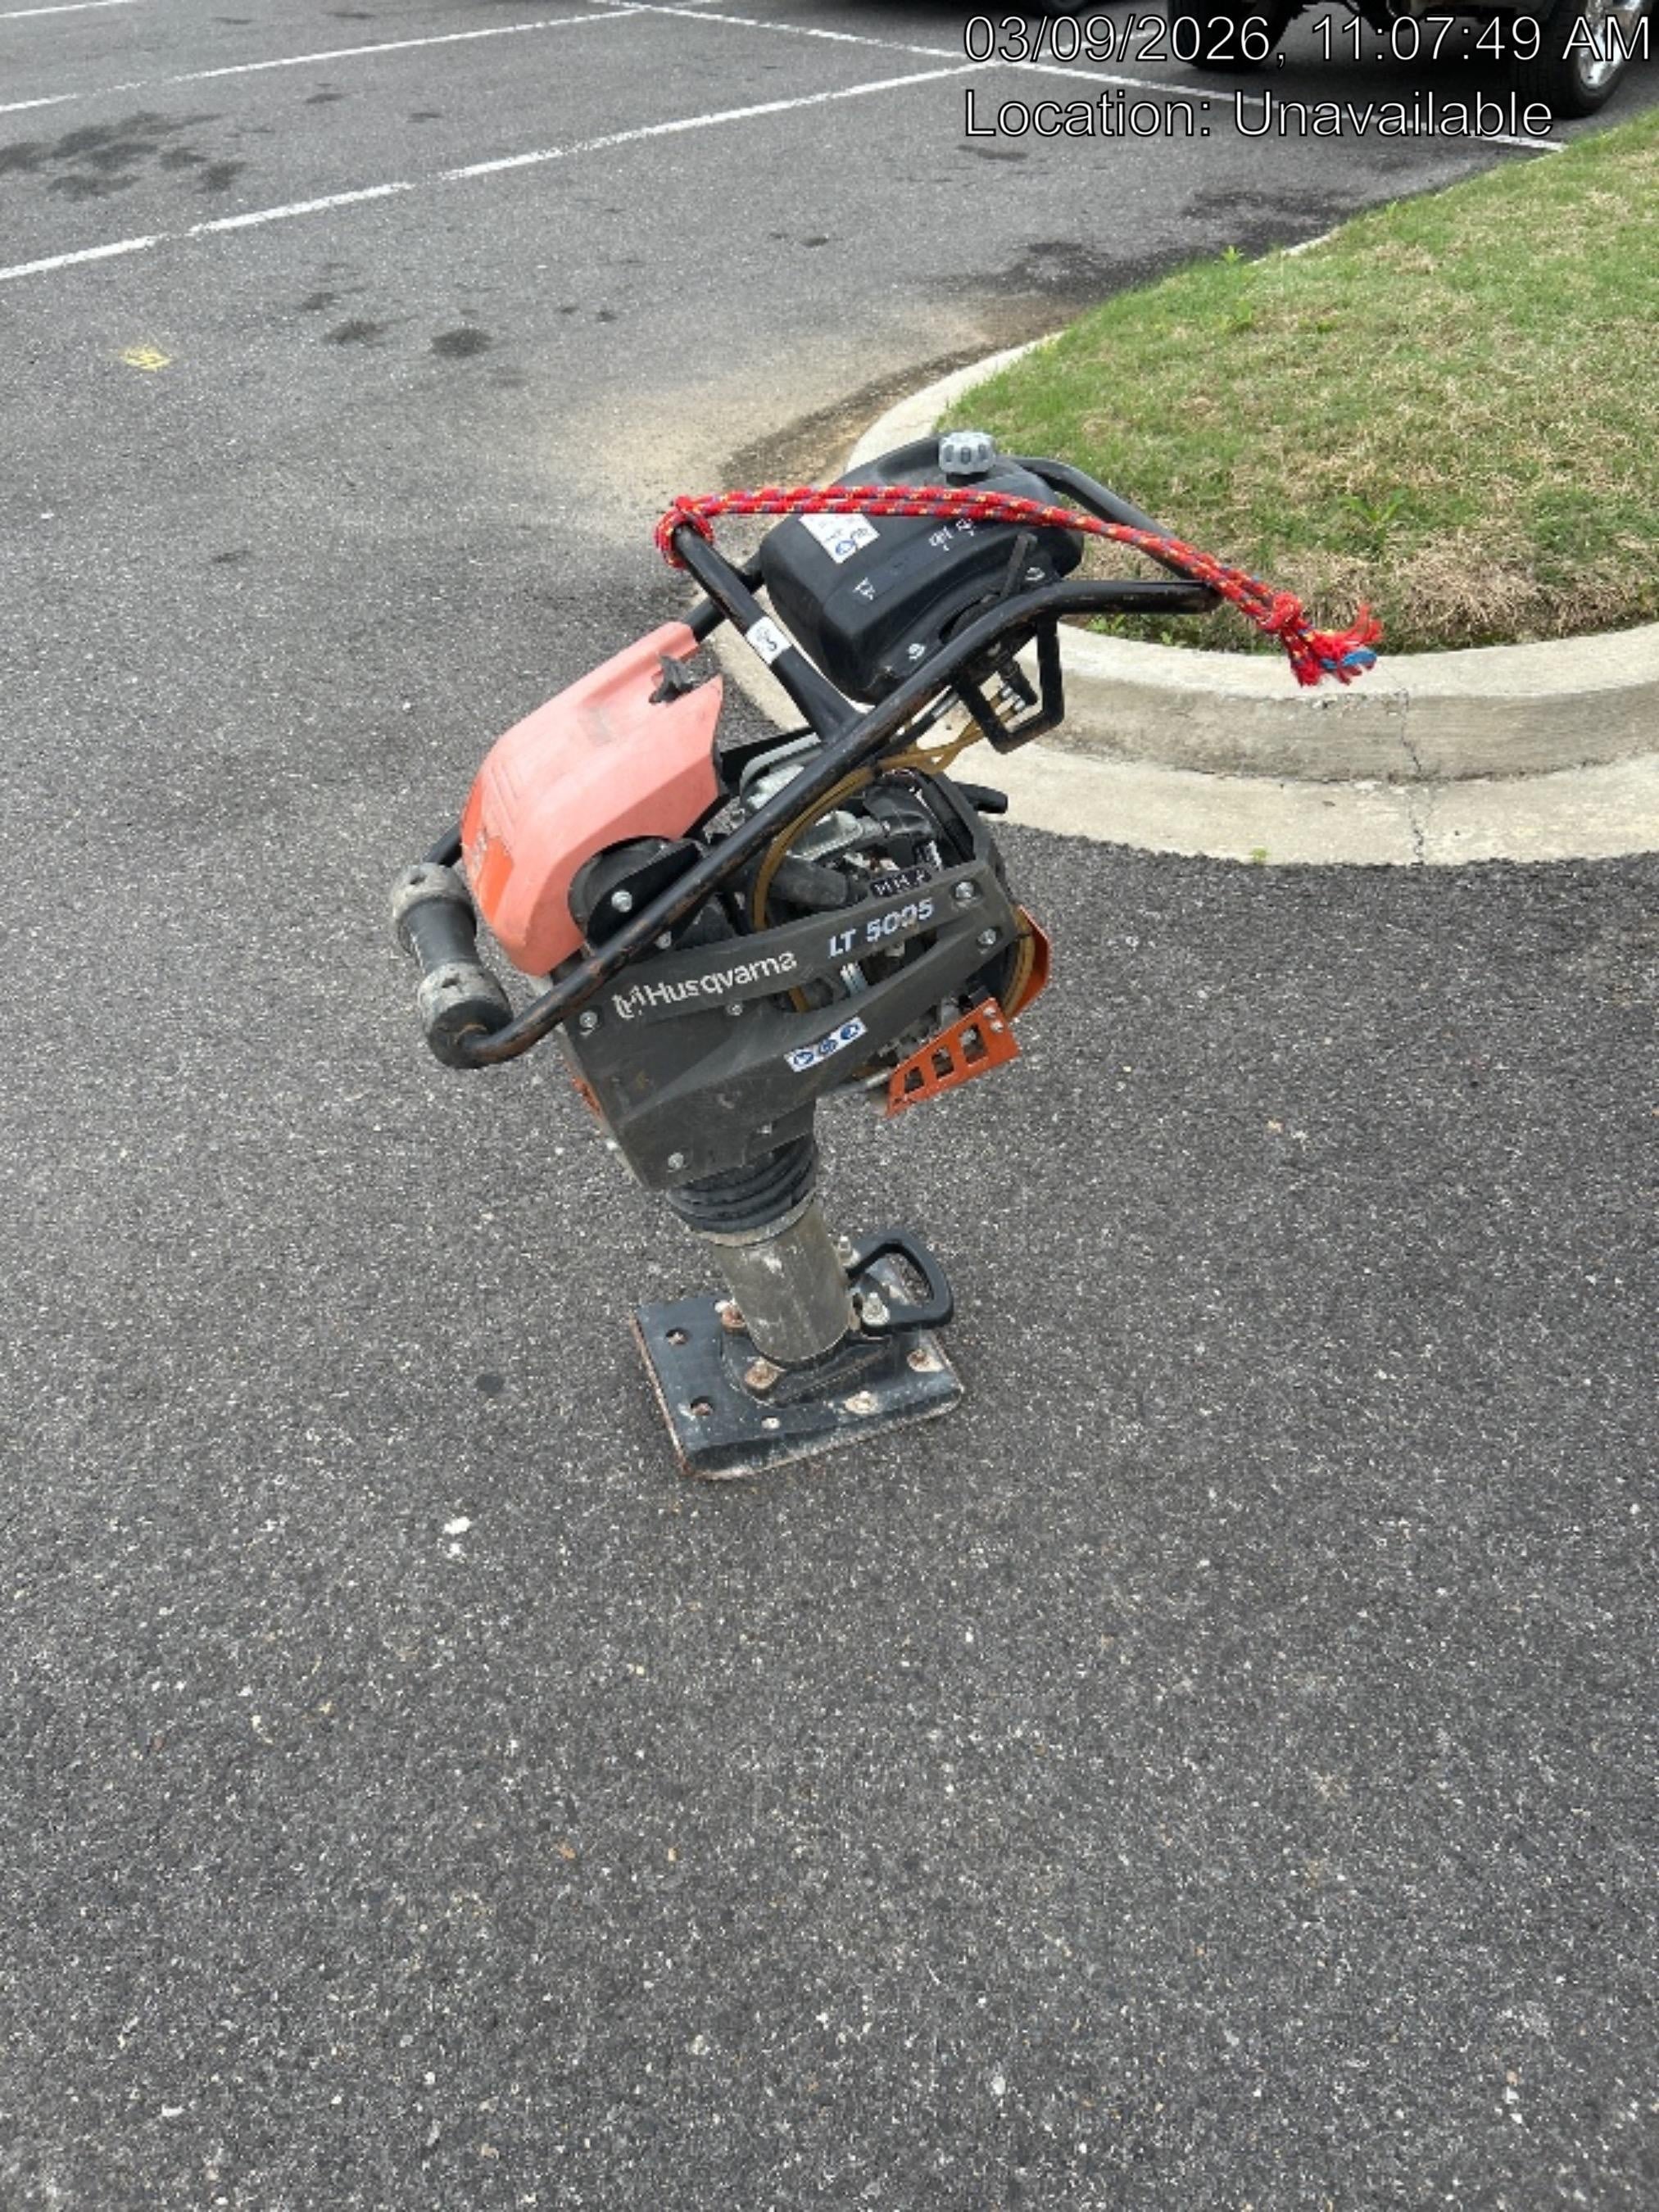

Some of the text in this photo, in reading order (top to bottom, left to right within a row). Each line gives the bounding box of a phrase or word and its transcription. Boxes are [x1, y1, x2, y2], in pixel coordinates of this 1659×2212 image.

[829, 896, 934, 958] LT 5005
[644, 950, 798, 1006] Husqvarna
